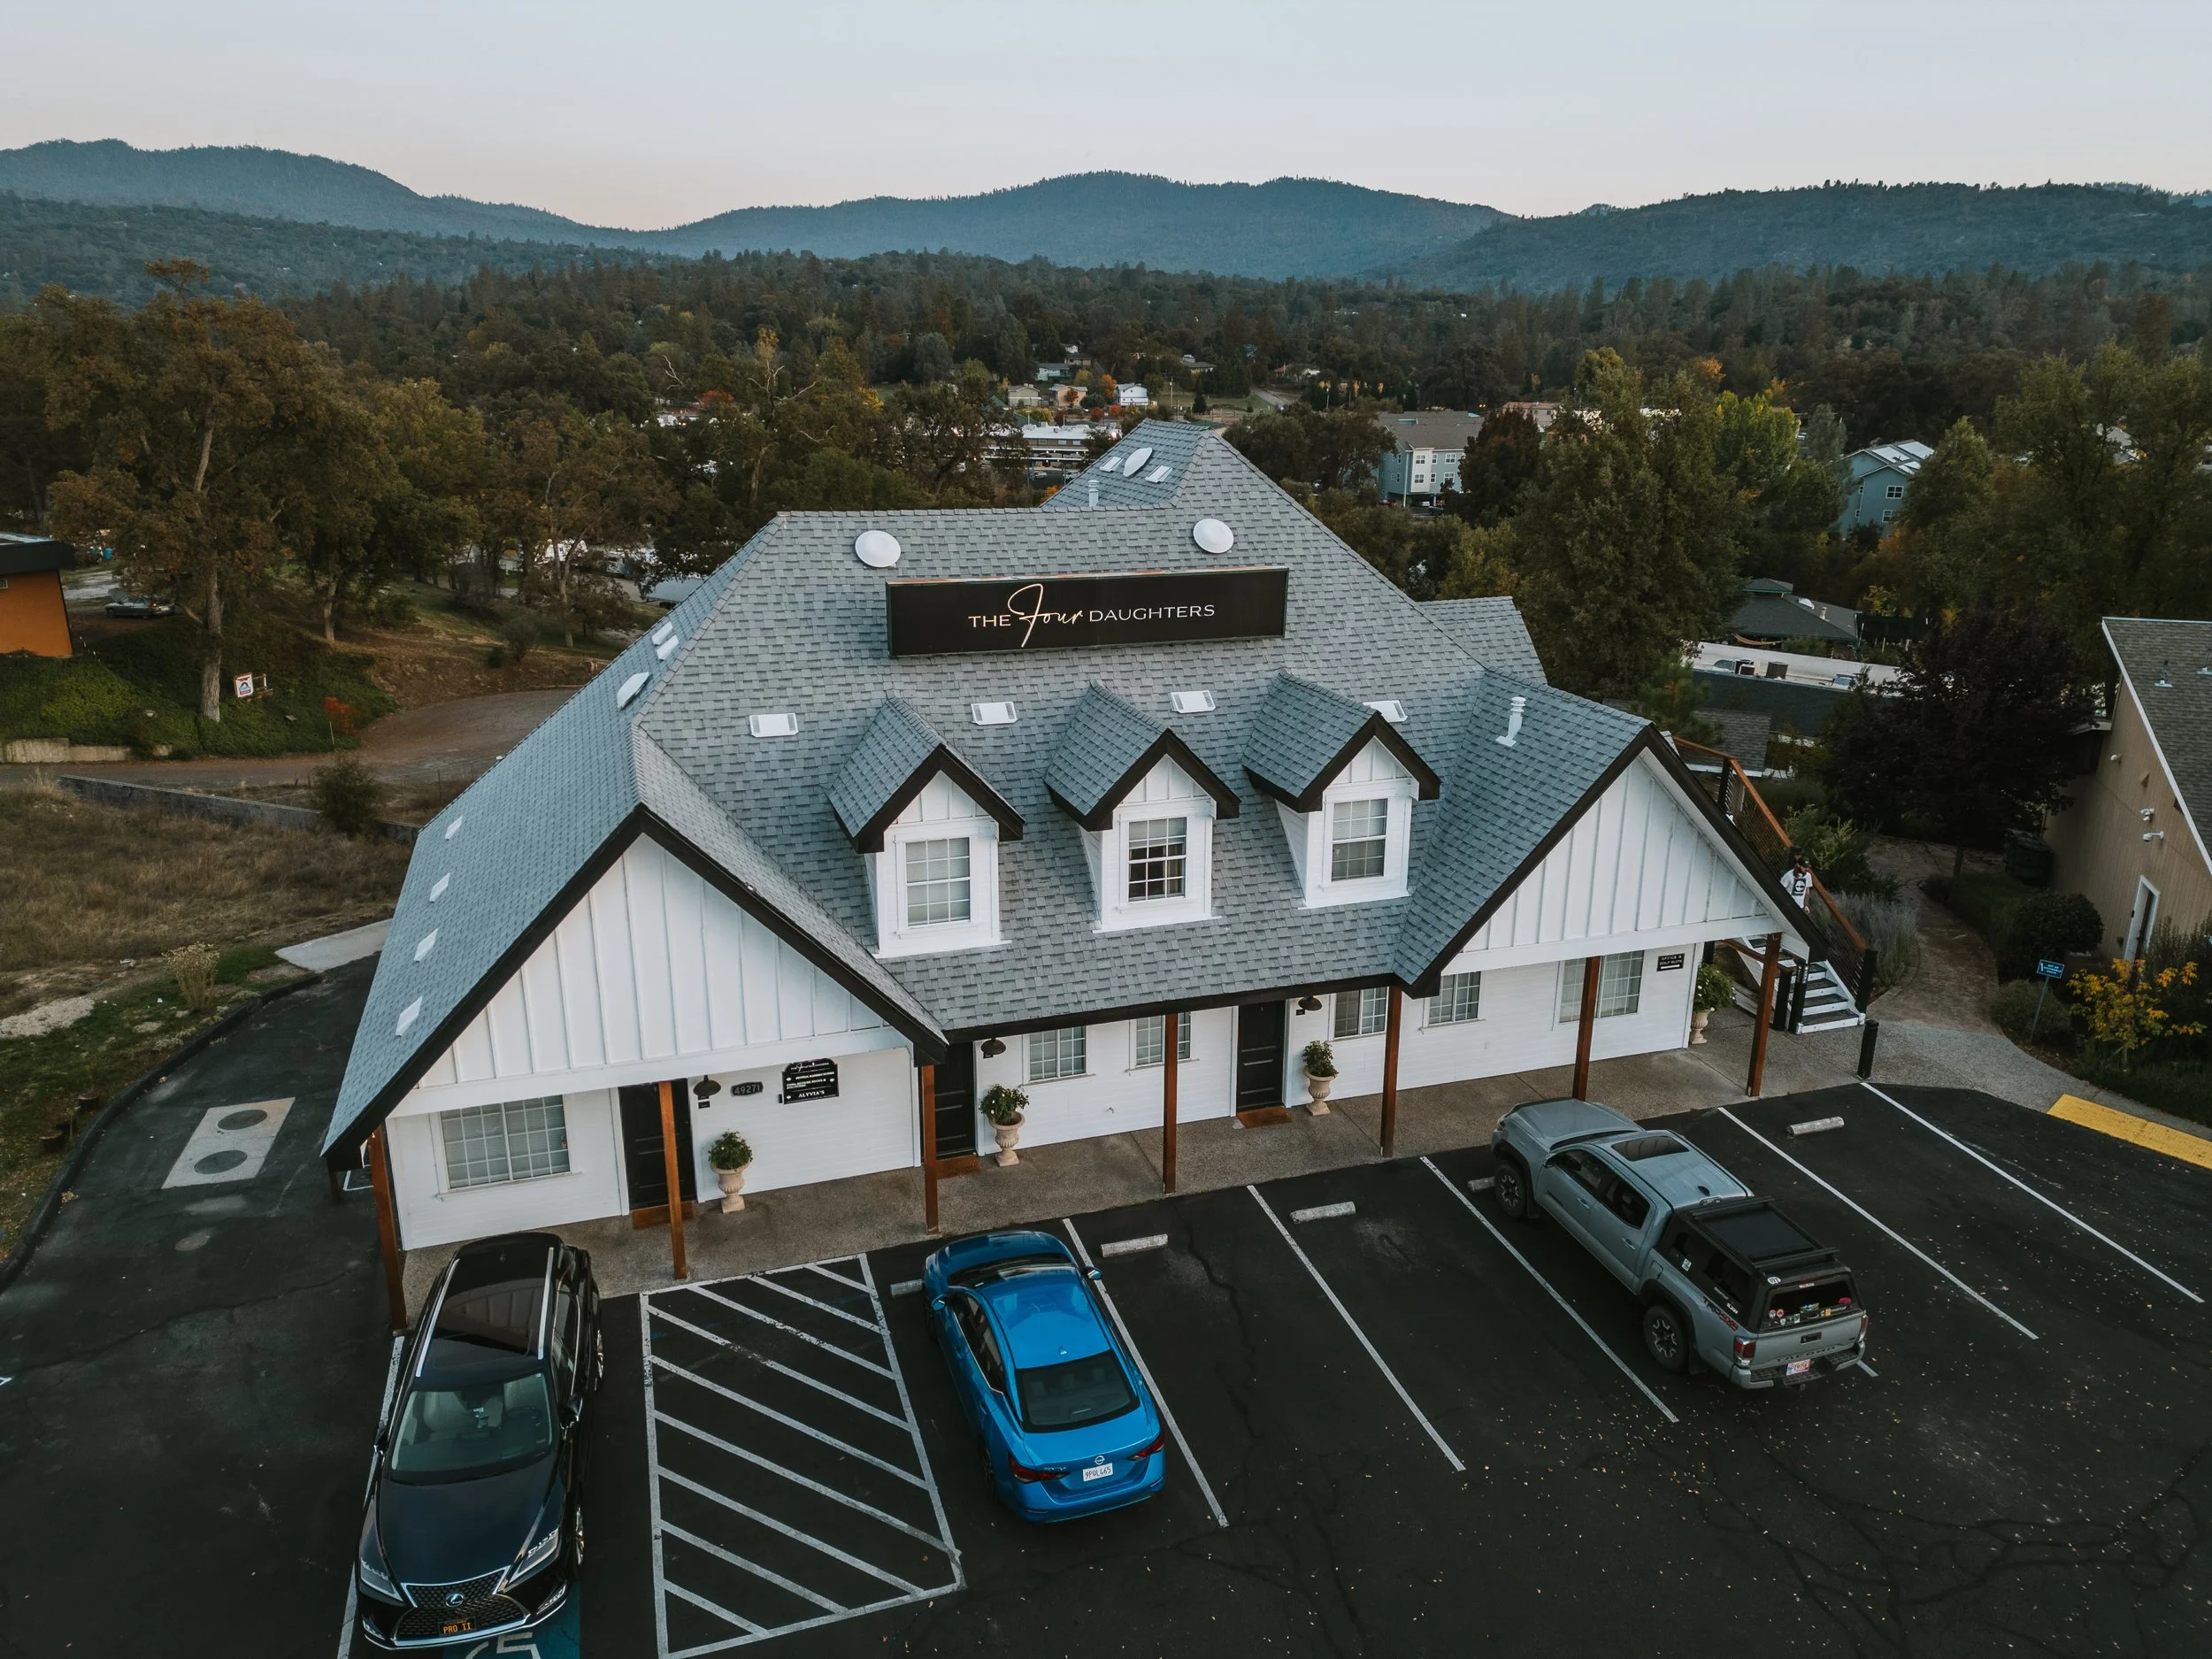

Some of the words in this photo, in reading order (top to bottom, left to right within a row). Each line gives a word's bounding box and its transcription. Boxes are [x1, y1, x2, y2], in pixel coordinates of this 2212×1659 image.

[968, 614, 1011, 628] THE
[1007, 583, 1084, 648] Four
[1089, 604, 1216, 623] DAUGHTERS
[734, 1083, 760, 1094] 49271
[798, 1089, 826, 1099] ALYVIA'S
[443, 1624, 458, 1634] PRO
